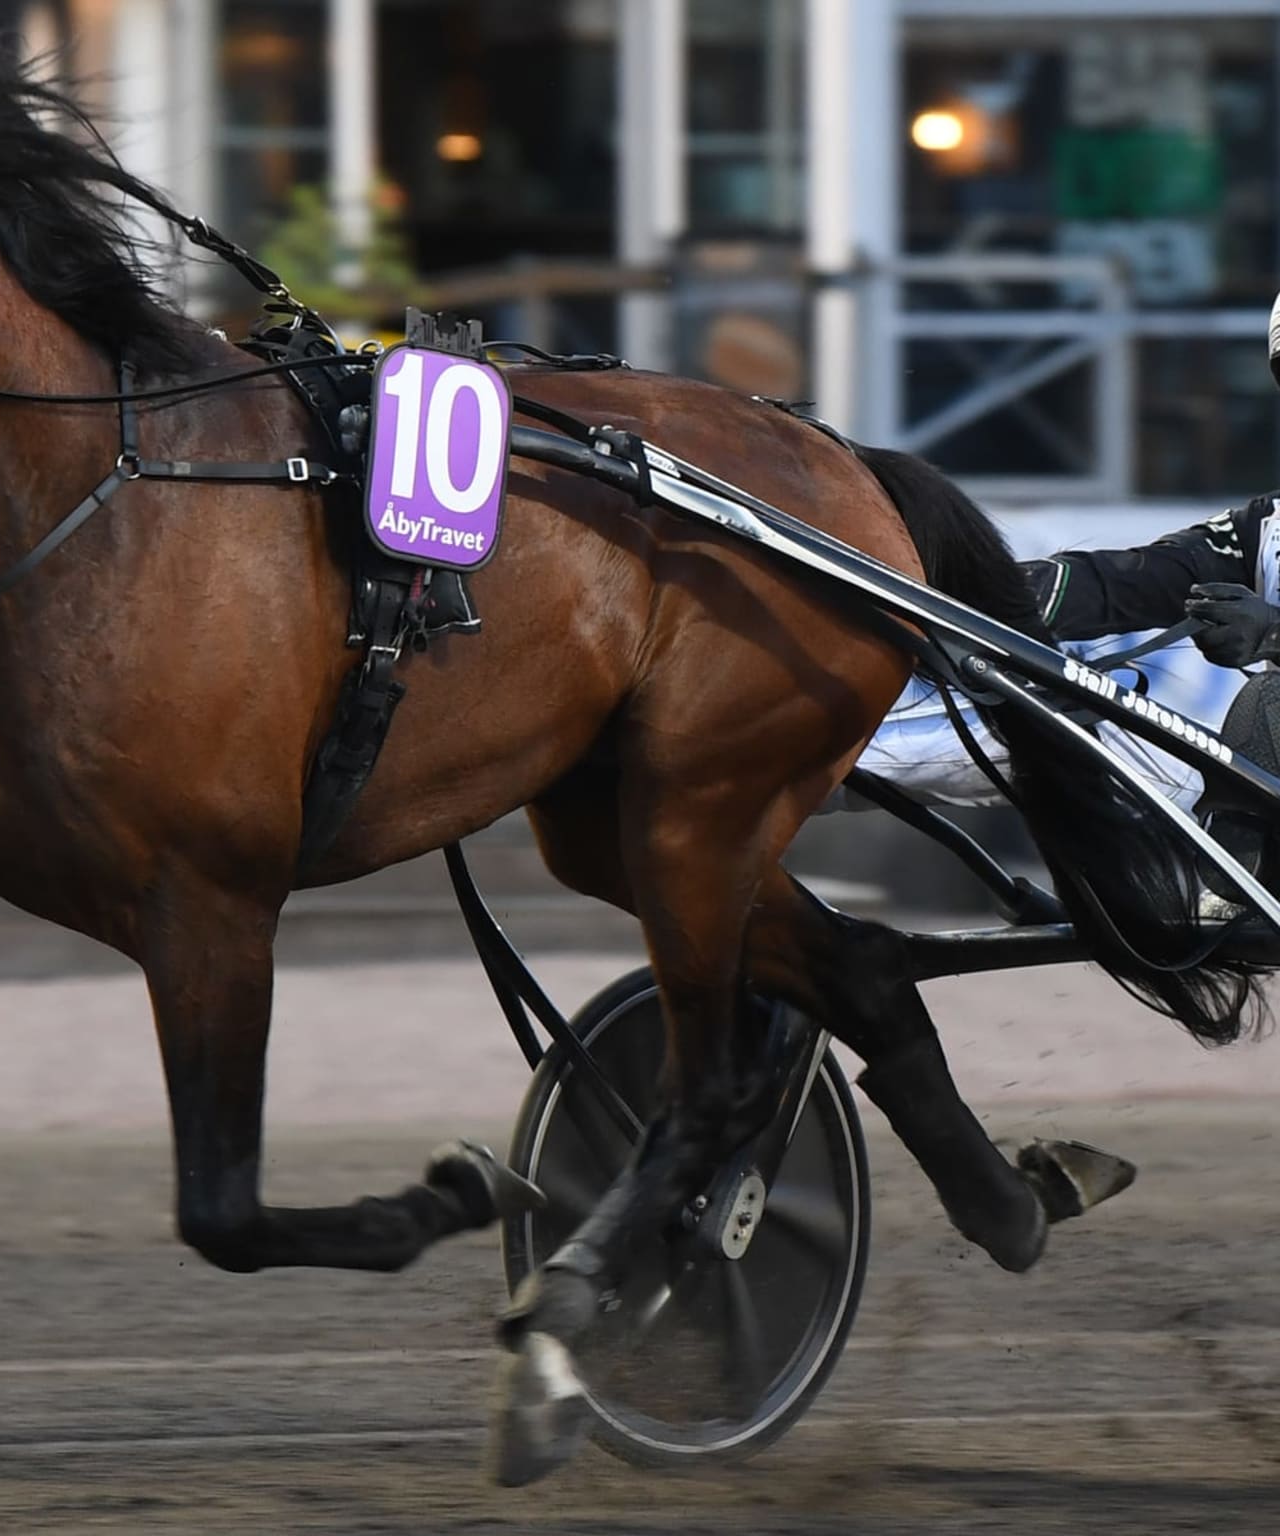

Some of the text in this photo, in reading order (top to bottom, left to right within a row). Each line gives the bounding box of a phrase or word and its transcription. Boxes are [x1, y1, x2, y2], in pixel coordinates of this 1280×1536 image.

[385, 353, 502, 514] 10
[378, 502, 484, 551] ÅbyTravet
[1063, 658, 1118, 700] Stall
